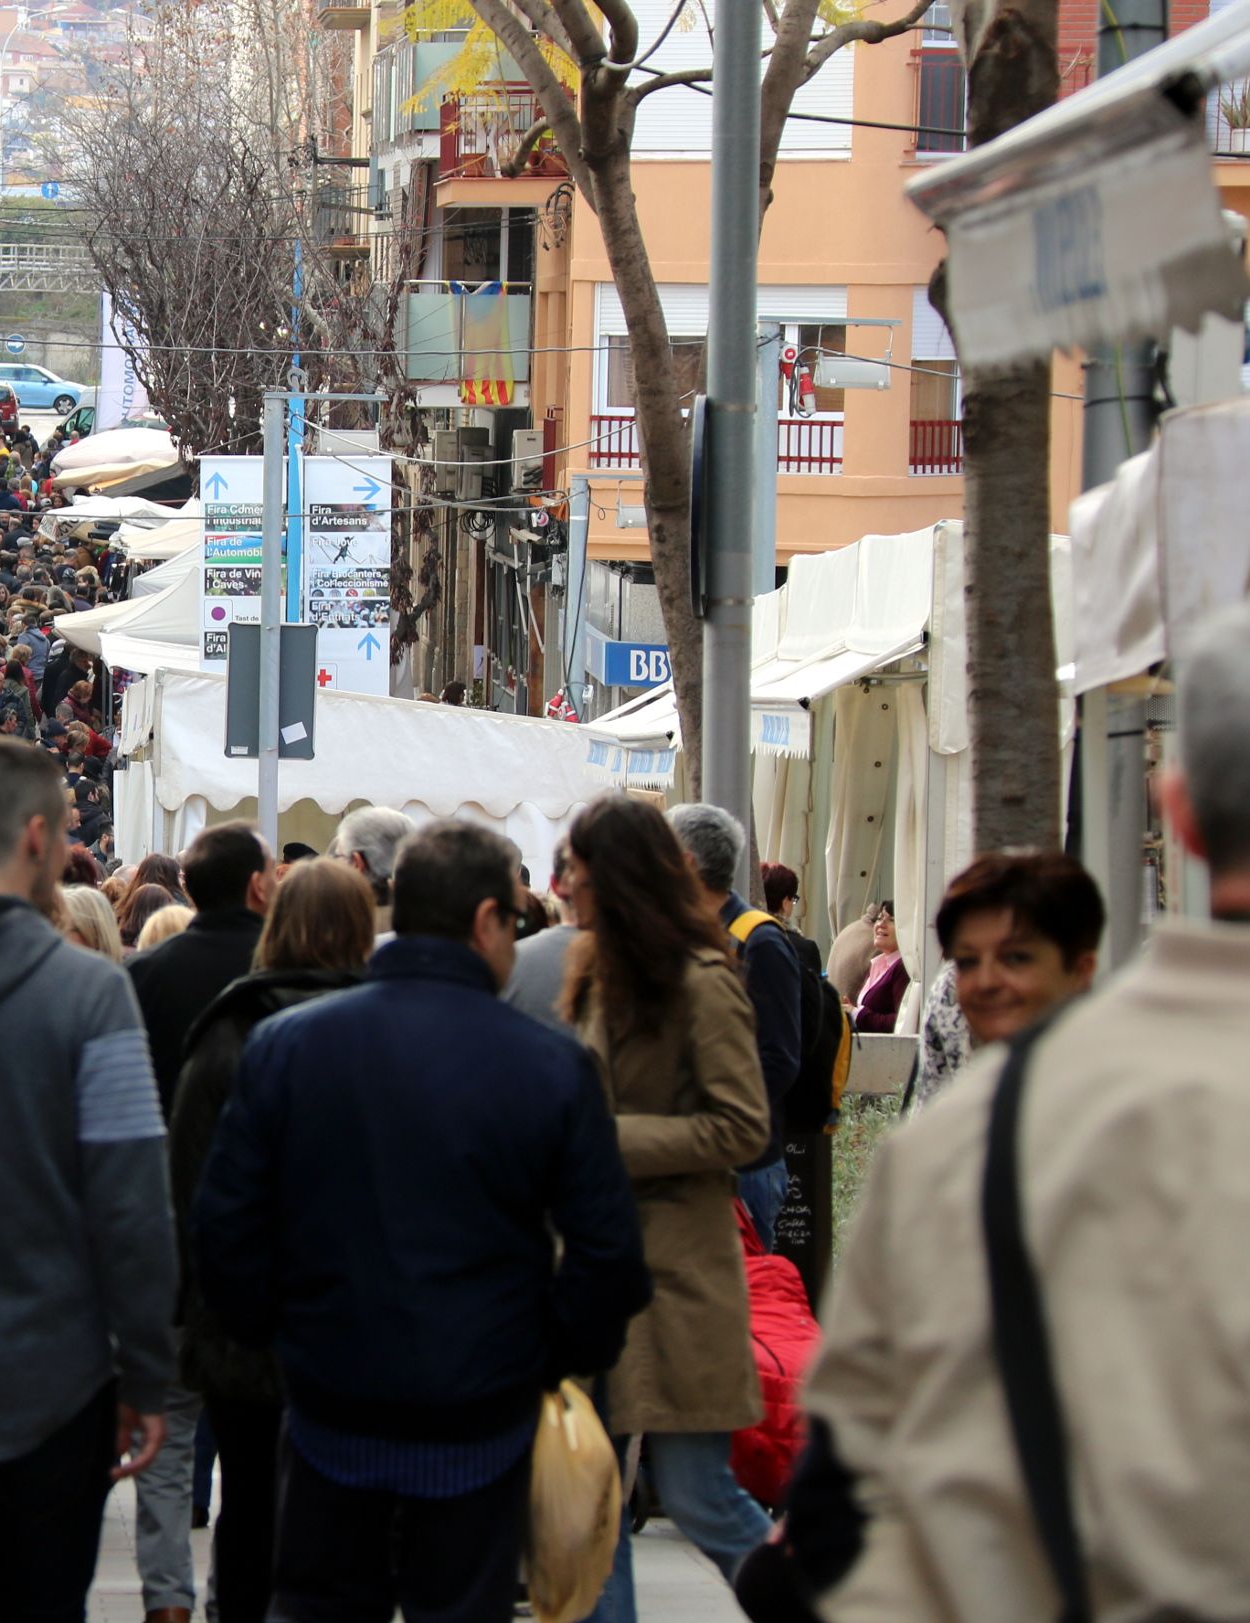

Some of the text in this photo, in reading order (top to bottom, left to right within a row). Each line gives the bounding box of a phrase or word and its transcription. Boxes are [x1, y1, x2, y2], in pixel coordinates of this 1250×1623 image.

[207, 504, 227, 514] Fira
[312, 505, 331, 514] Fira
[312, 516, 367, 525] d'Artesans
[207, 536, 242, 546] Fira de
[207, 568, 227, 578] Fira
[229, 568, 242, 578] de
[312, 570, 330, 578] Fira
[206, 633, 226, 643] Fira
